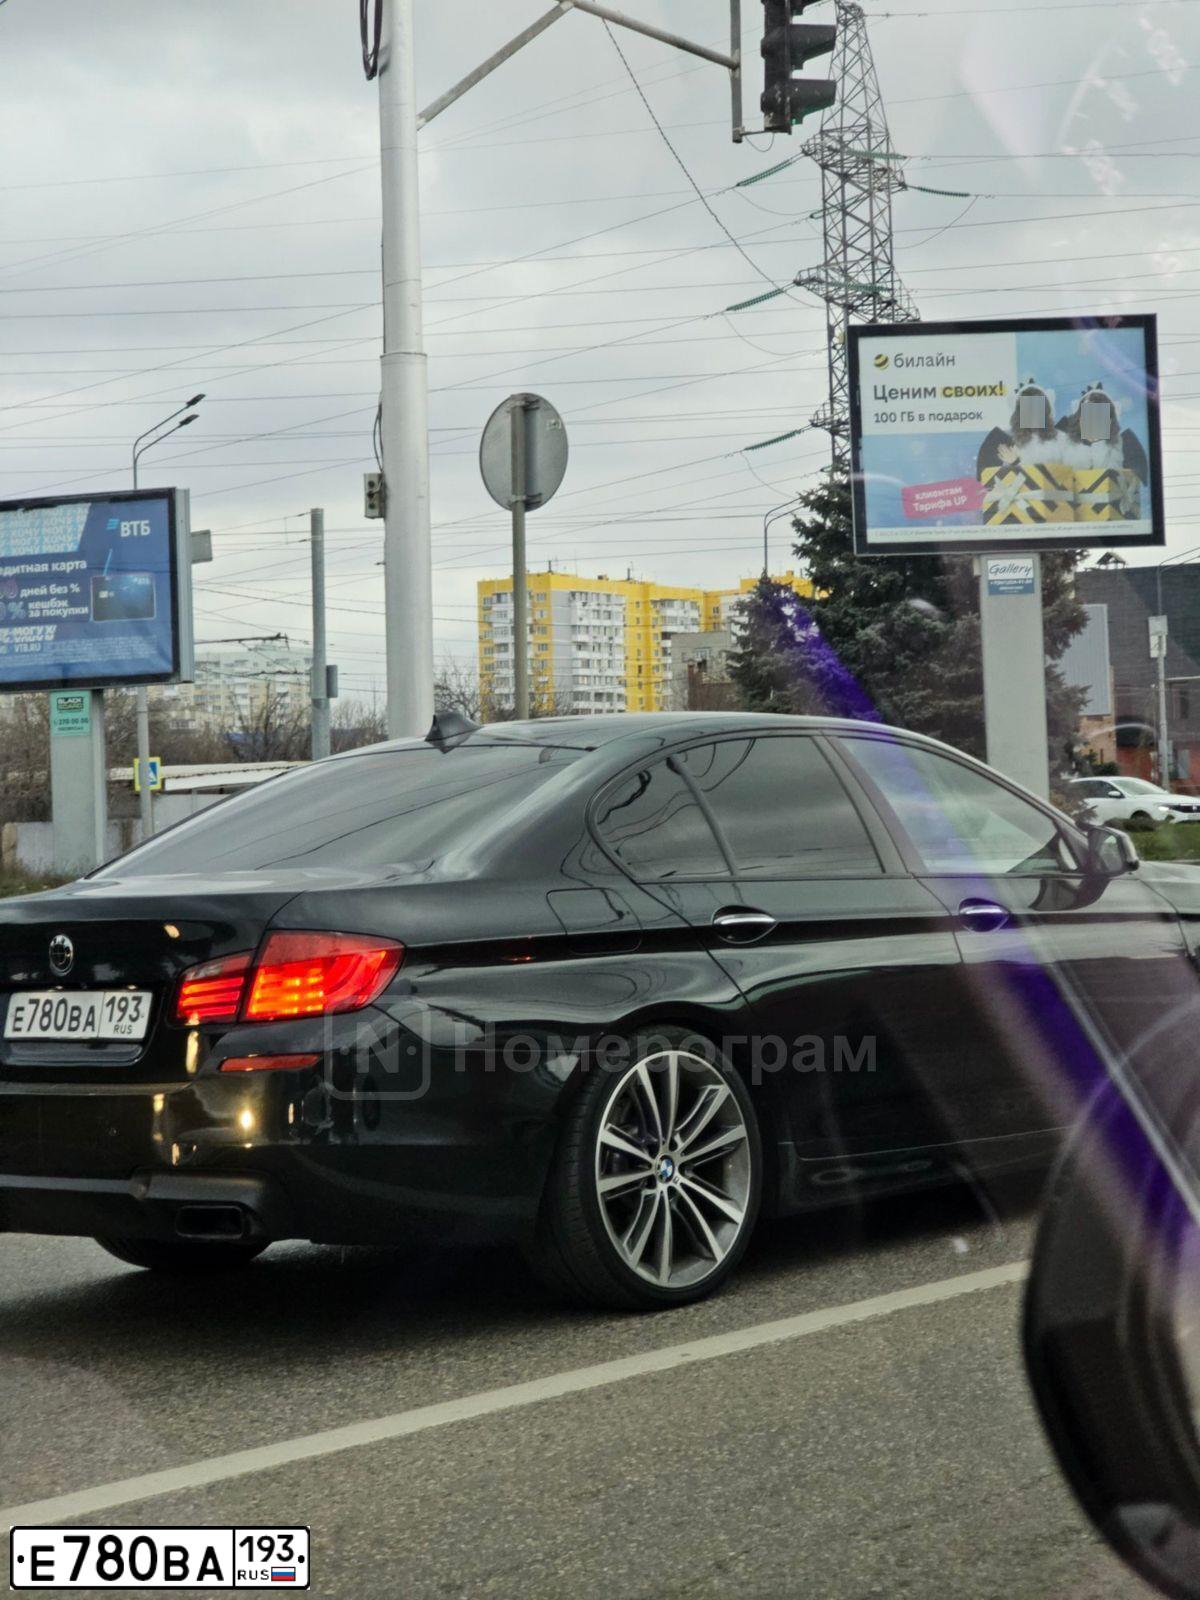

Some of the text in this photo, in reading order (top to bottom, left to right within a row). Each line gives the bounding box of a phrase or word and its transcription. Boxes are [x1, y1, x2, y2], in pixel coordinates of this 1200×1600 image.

[894, 353, 955, 368] билайн
[874, 380, 1004, 403] Ценим своих!
[874, 411, 983, 423] 100 ГБ в подарок
[912, 495, 967, 512] Тарифа UP
[120, 520, 151, 537] ВТБ
[51, 560, 87, 573] карта
[990, 563, 1032, 576] Gallery
[20, 585, 47, 598] дней
[49, 583, 68, 594] без
[69, 583, 80, 593] %
[28, 606, 89, 618] за покупки
[12, 995, 142, 1032] Е780ВА 193
[113, 1024, 133, 1035] RUS
